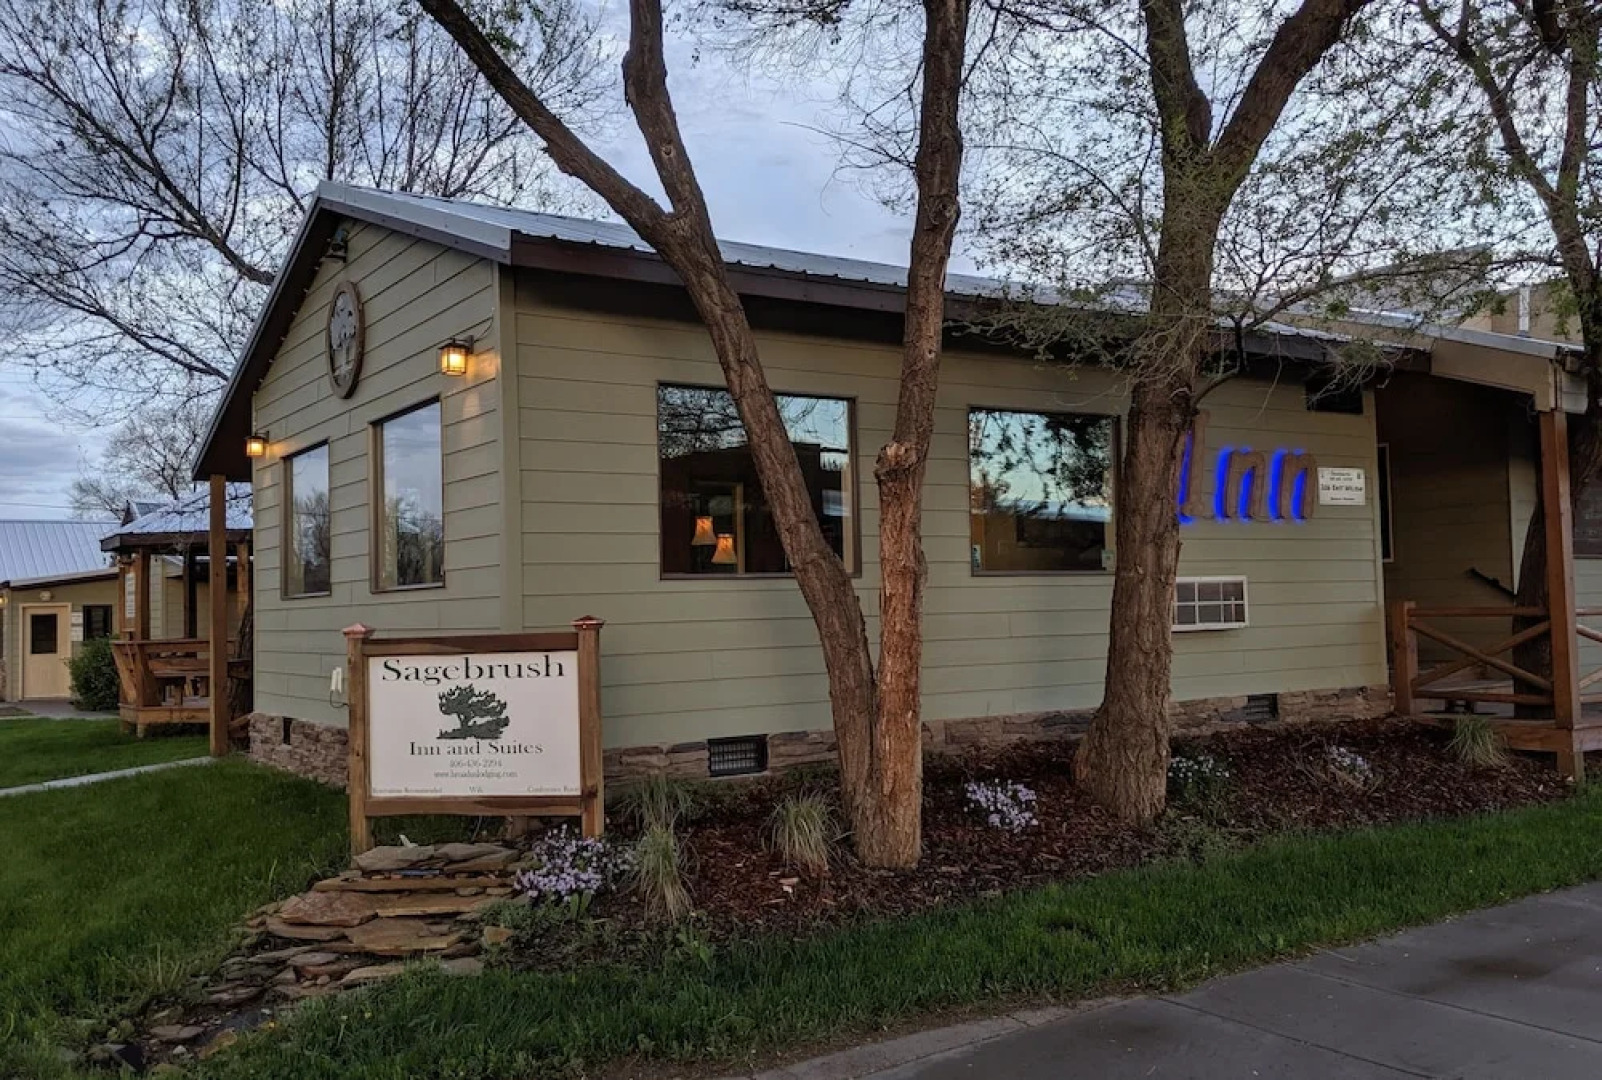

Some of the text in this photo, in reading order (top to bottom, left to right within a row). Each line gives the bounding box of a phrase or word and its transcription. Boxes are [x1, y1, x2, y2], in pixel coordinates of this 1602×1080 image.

[382, 654, 565, 685] Sagebrush
[409, 739, 544, 756] Inn and Suites
